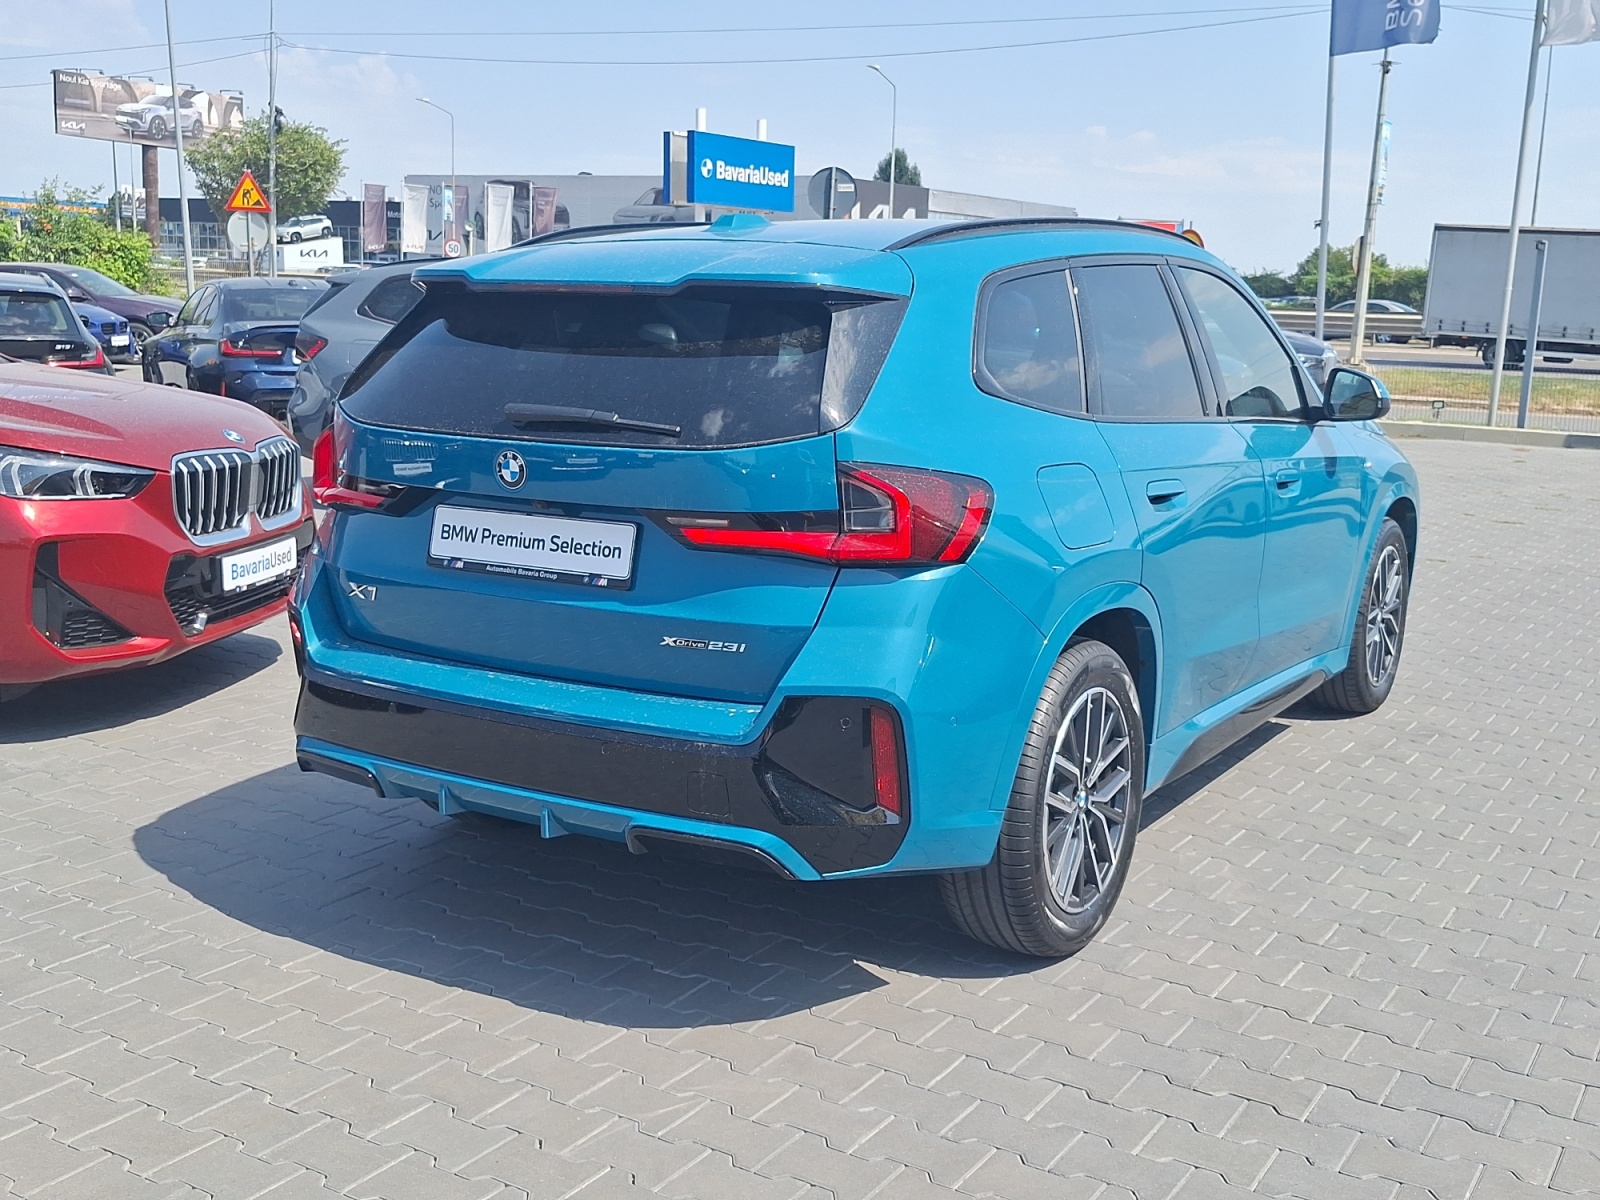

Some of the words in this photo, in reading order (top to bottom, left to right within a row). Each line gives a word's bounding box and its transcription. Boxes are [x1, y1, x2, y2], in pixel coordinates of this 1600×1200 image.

[60, 73, 77, 83] Noul
[78, 75, 90, 86] Kia
[91, 80, 122, 92] Sportage
[61, 120, 86, 130] KIA
[716, 160, 789, 188] BavariaUsed
[429, 184, 443, 196] NO
[300, 248, 329, 258] KIA
[448, 244, 459, 254] 50
[440, 523, 479, 543] BMW
[481, 527, 546, 551] Premium
[549, 534, 622, 560] Selection
[231, 546, 293, 581] BavariaUsed
[485, 564, 518, 575] Automobile
[517, 568, 539, 577] Bavaria
[539, 571, 558, 581] Group
[348, 581, 377, 602] X1
